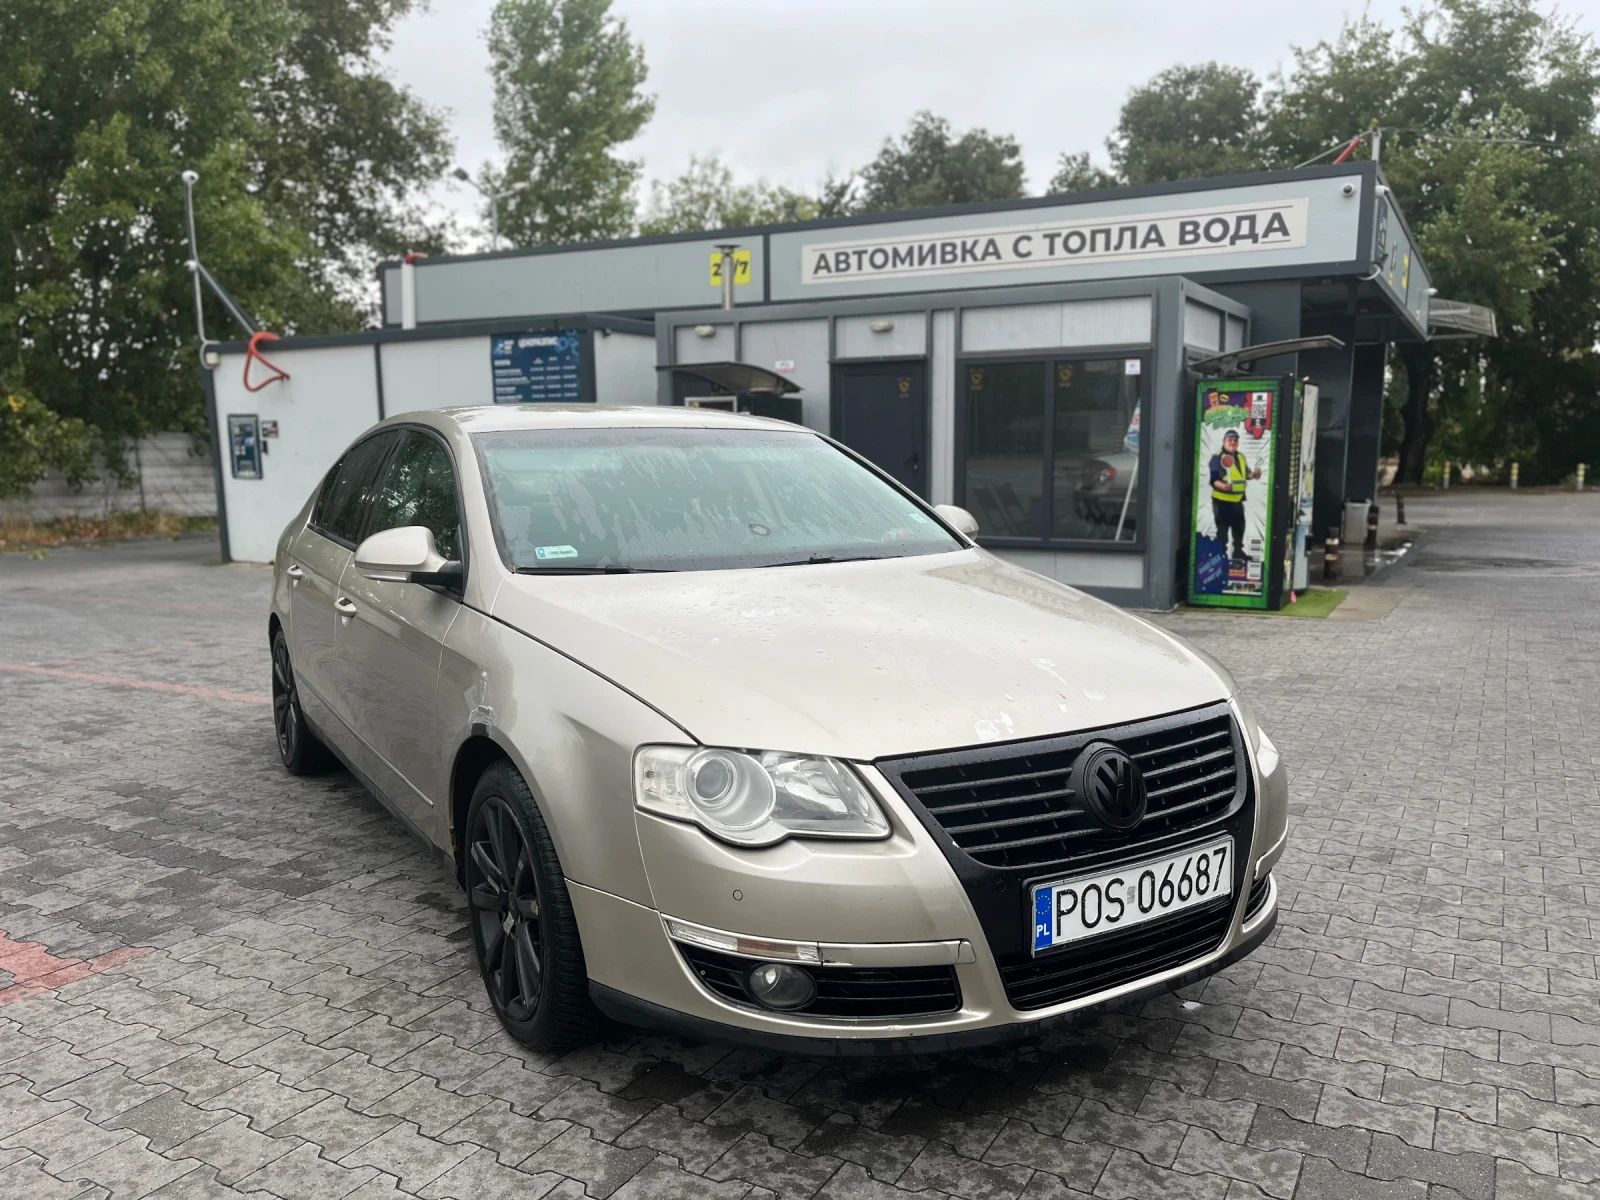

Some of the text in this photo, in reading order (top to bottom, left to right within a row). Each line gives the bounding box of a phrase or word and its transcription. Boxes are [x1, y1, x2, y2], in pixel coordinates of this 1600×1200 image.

[813, 211, 1291, 275] АВТОМИВКА С ТОПЛА ВОДА
[712, 258, 749, 277] 2/7
[1055, 846, 1228, 937] POS 06687
[1036, 923, 1050, 938] PL
